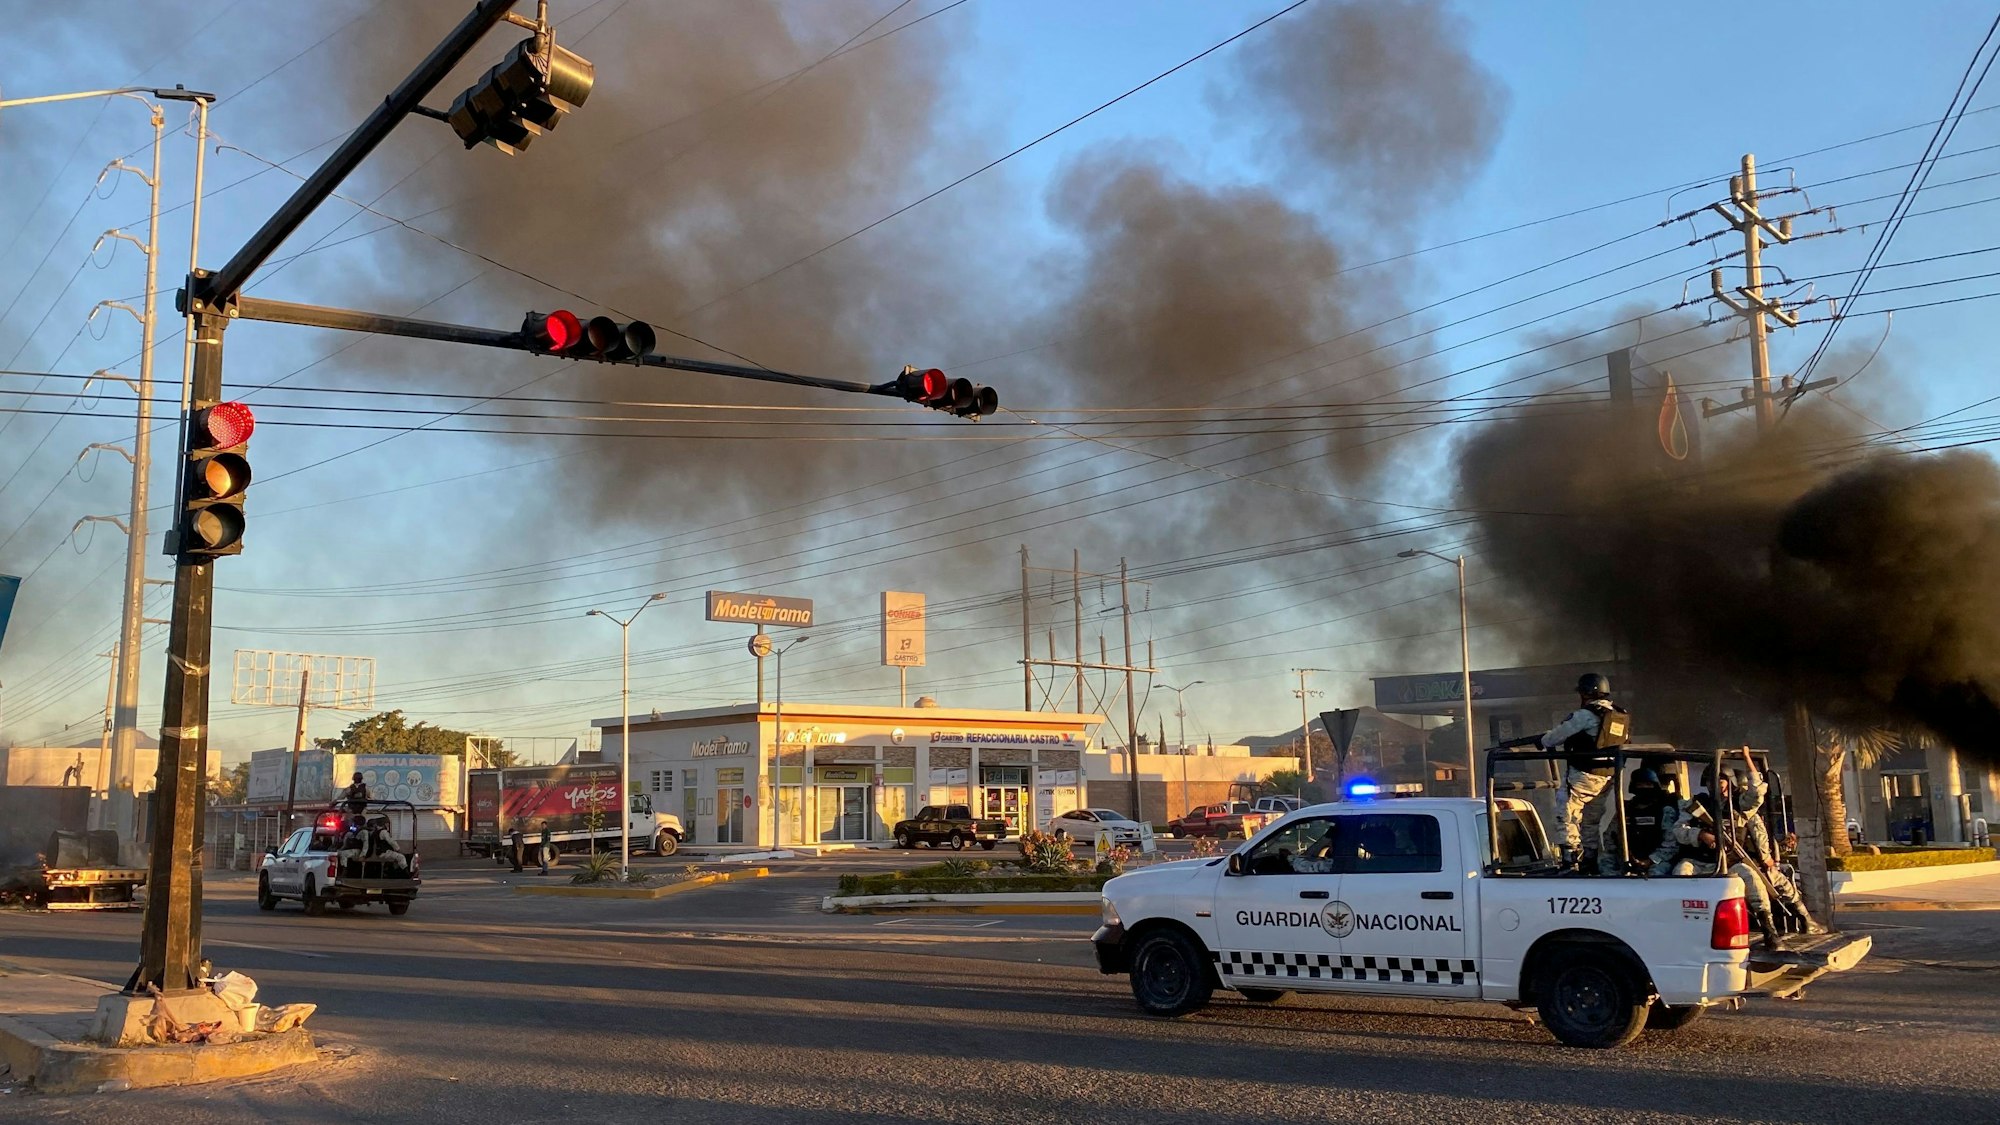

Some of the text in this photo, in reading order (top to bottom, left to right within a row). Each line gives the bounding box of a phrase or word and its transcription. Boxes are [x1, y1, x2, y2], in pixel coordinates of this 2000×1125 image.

[894, 654, 918, 662] CASTRO
[966, 733, 1060, 744] REFACCIONARIA CASTRO
[395, 757, 407, 766] LA
[1547, 897, 1602, 914] 17223
[1236, 910, 1461, 932] GUARDIA NACIONAL
